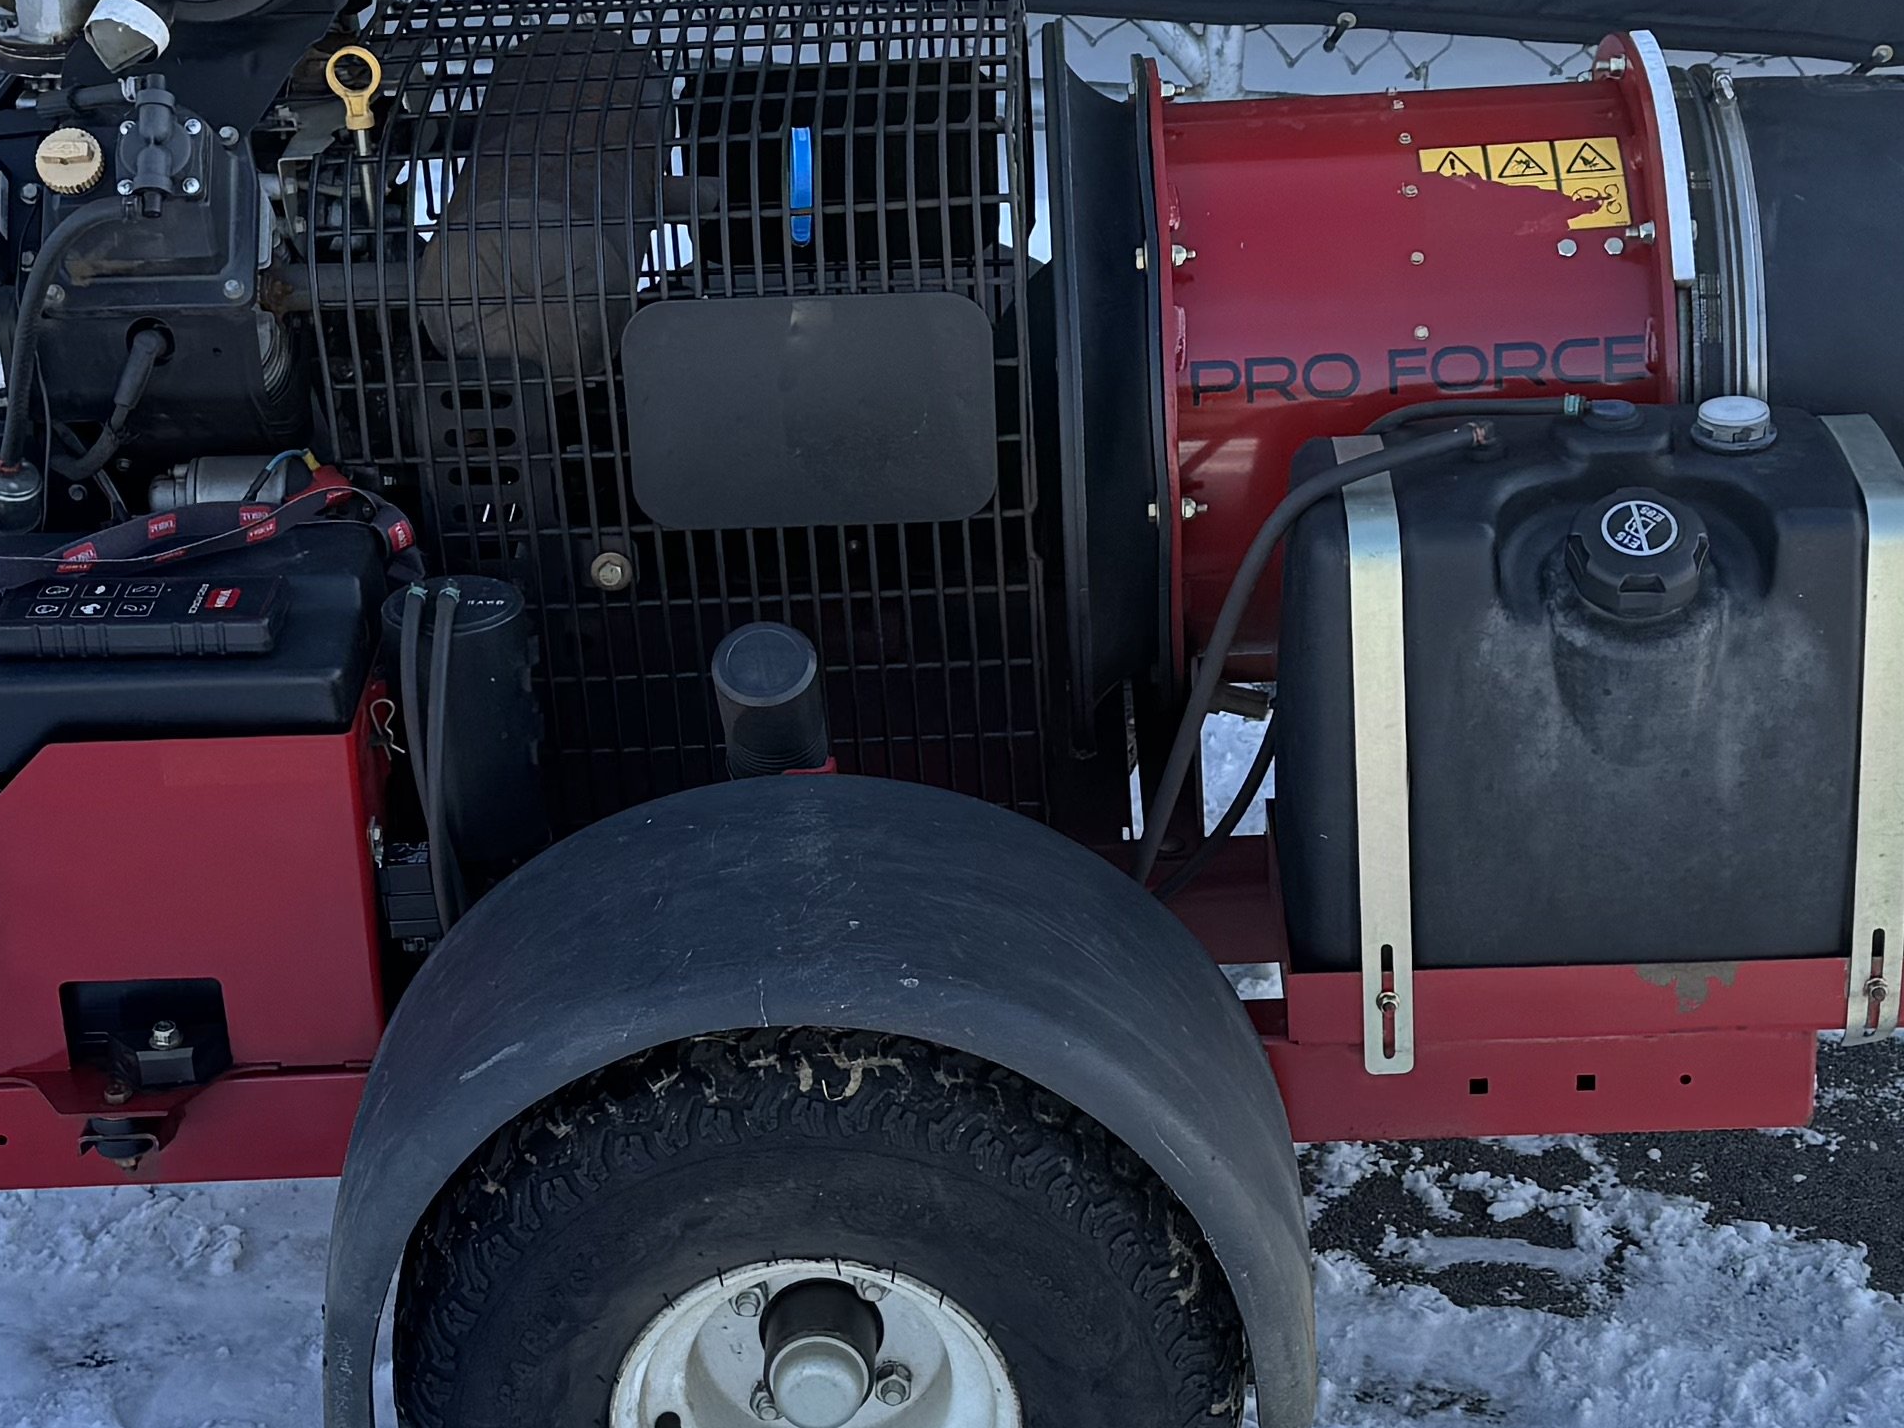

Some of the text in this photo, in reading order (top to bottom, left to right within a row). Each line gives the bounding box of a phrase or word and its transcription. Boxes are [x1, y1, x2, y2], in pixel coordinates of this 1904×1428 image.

[1190, 335, 1647, 406] PRO FORCE
[1615, 531, 1641, 549] E15
